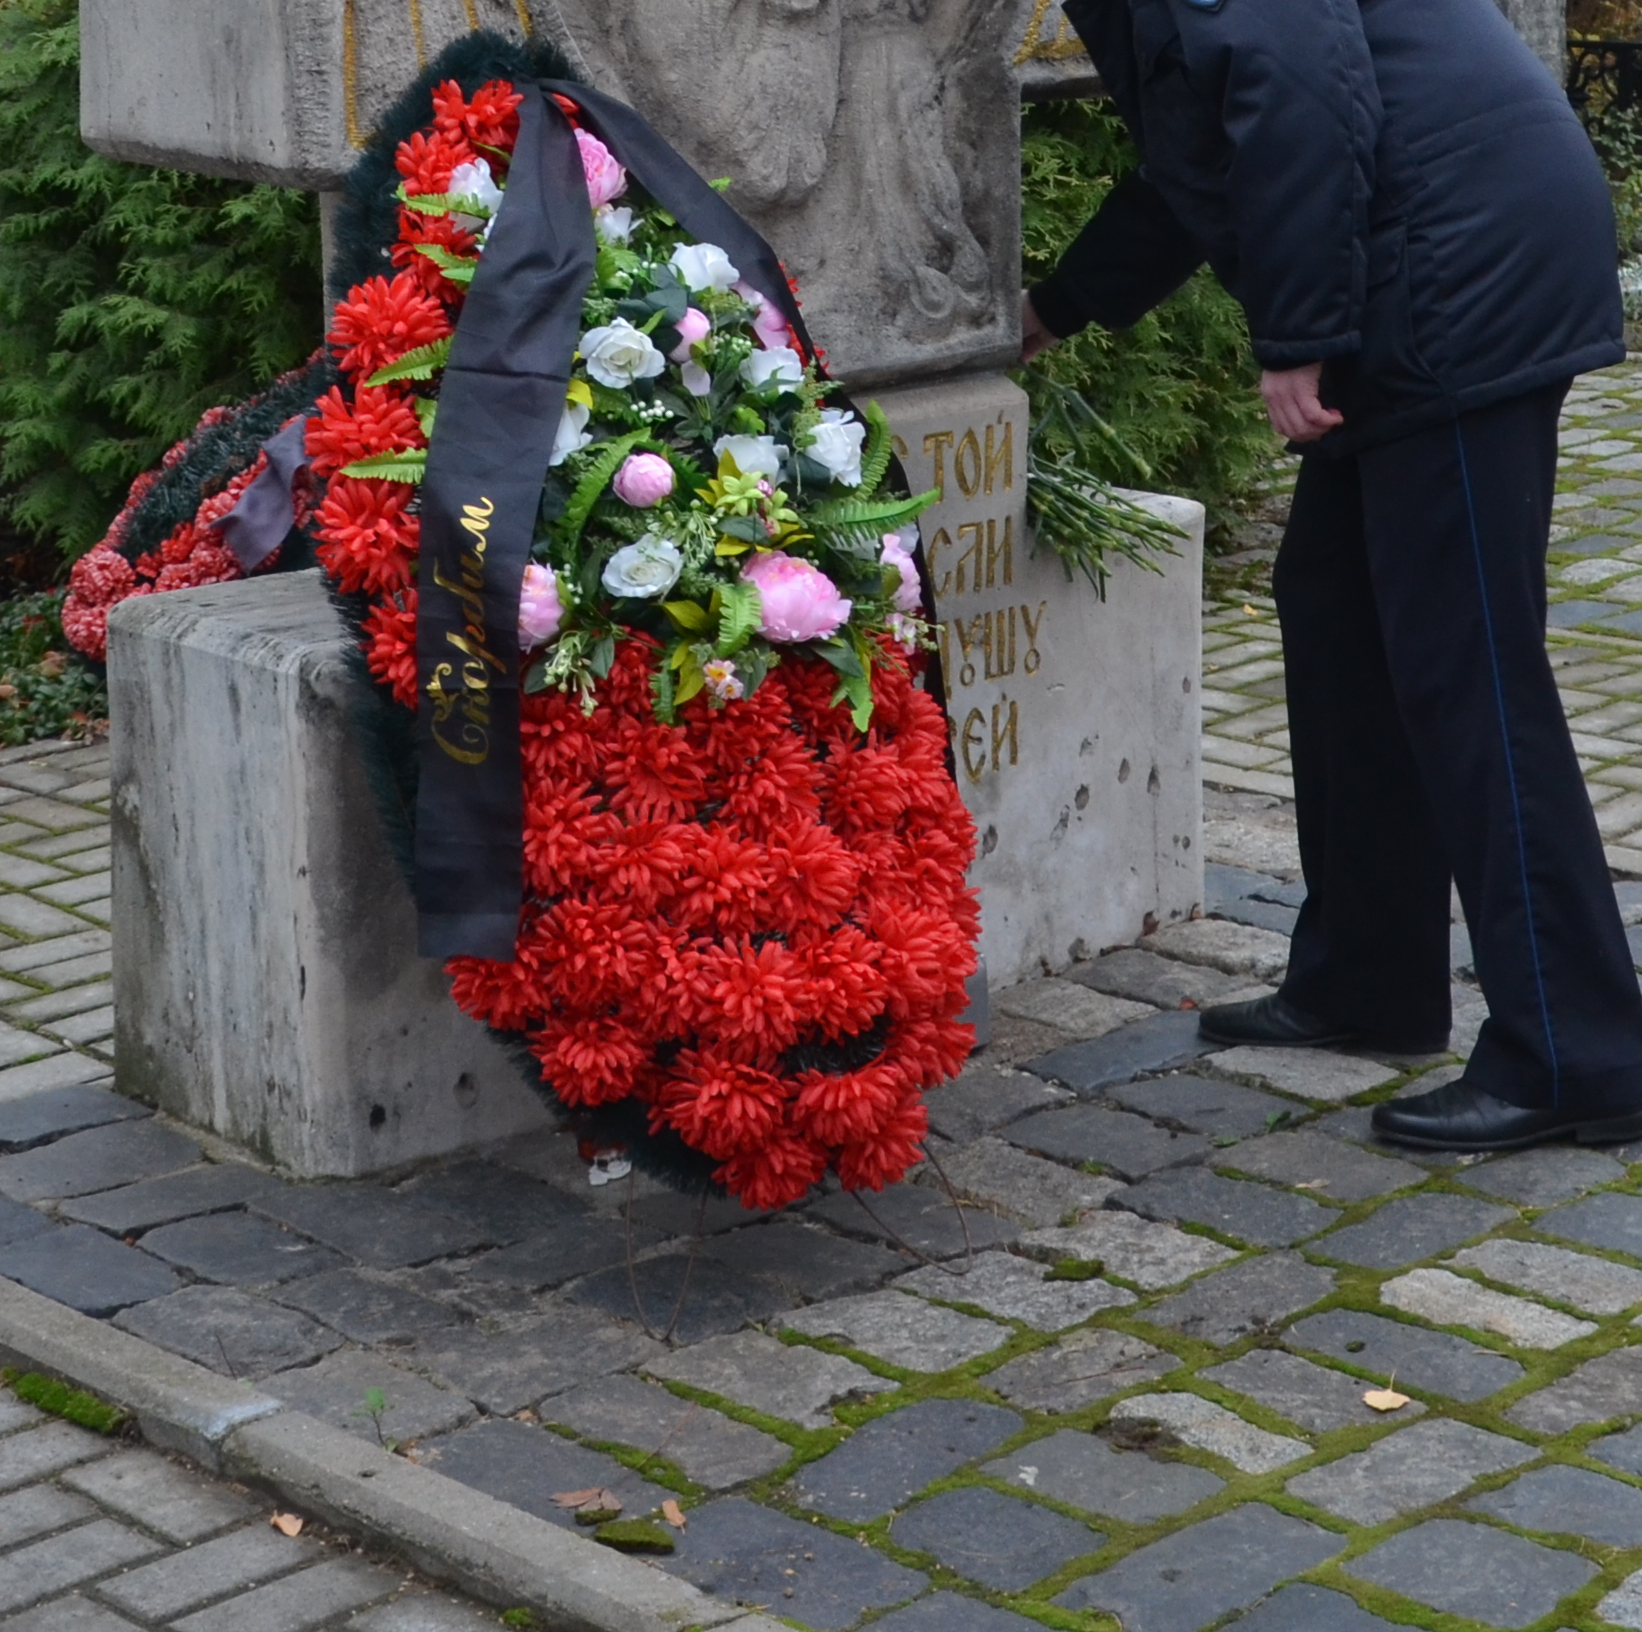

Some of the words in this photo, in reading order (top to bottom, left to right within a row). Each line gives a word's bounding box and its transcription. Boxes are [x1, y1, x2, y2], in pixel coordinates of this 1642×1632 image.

[924, 411, 1013, 504] ТОЙ
[927, 515, 1013, 598] СЛИ
[426, 497, 507, 765] Скорбим
